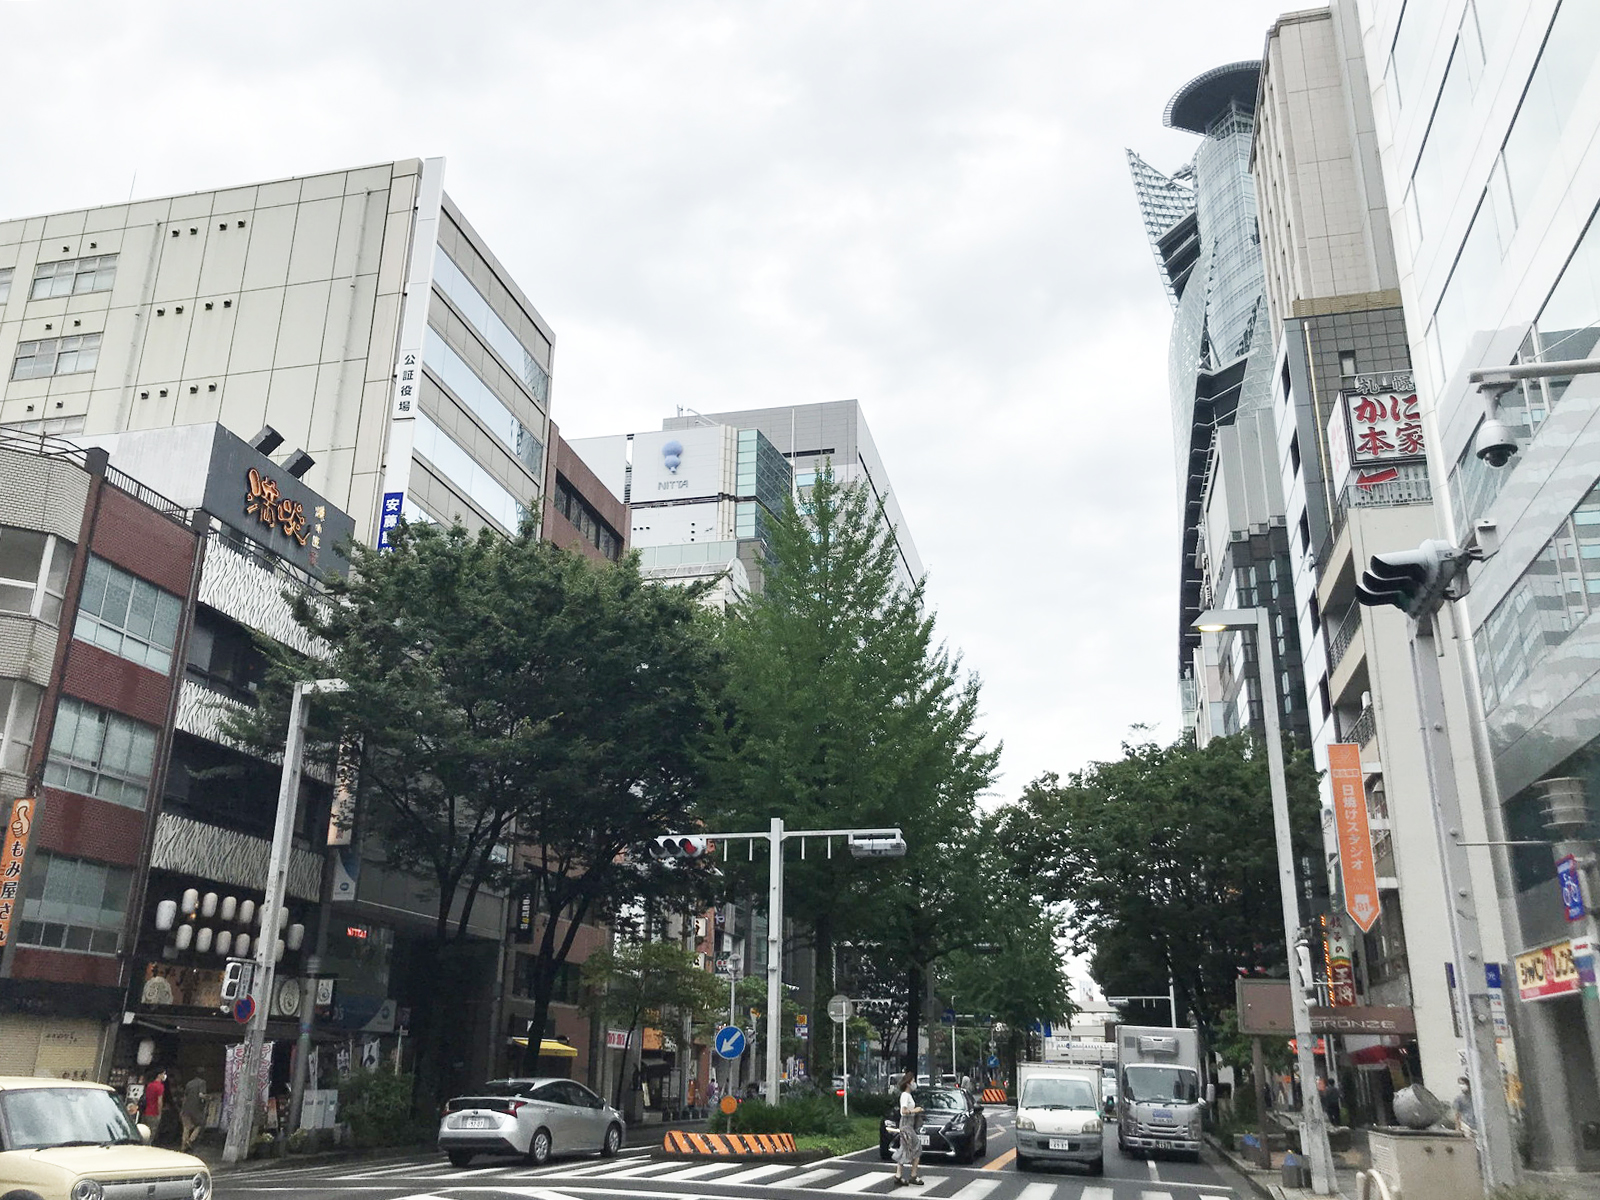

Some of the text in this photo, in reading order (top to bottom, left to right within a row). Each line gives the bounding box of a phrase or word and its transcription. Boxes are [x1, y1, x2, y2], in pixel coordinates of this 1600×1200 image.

[398, 354, 416, 412] 公証役場
[1356, 375, 1415, 395] 札幌
[1353, 395, 1421, 424] かに
[1356, 422, 1426, 457] 本家
[657, 479, 689, 490] NITTA
[1342, 784, 1364, 870] 日焼けスタジオ
[1330, 916, 1354, 1005] 餃子の王将
[1310, 1019, 1396, 1030] BRONZE
